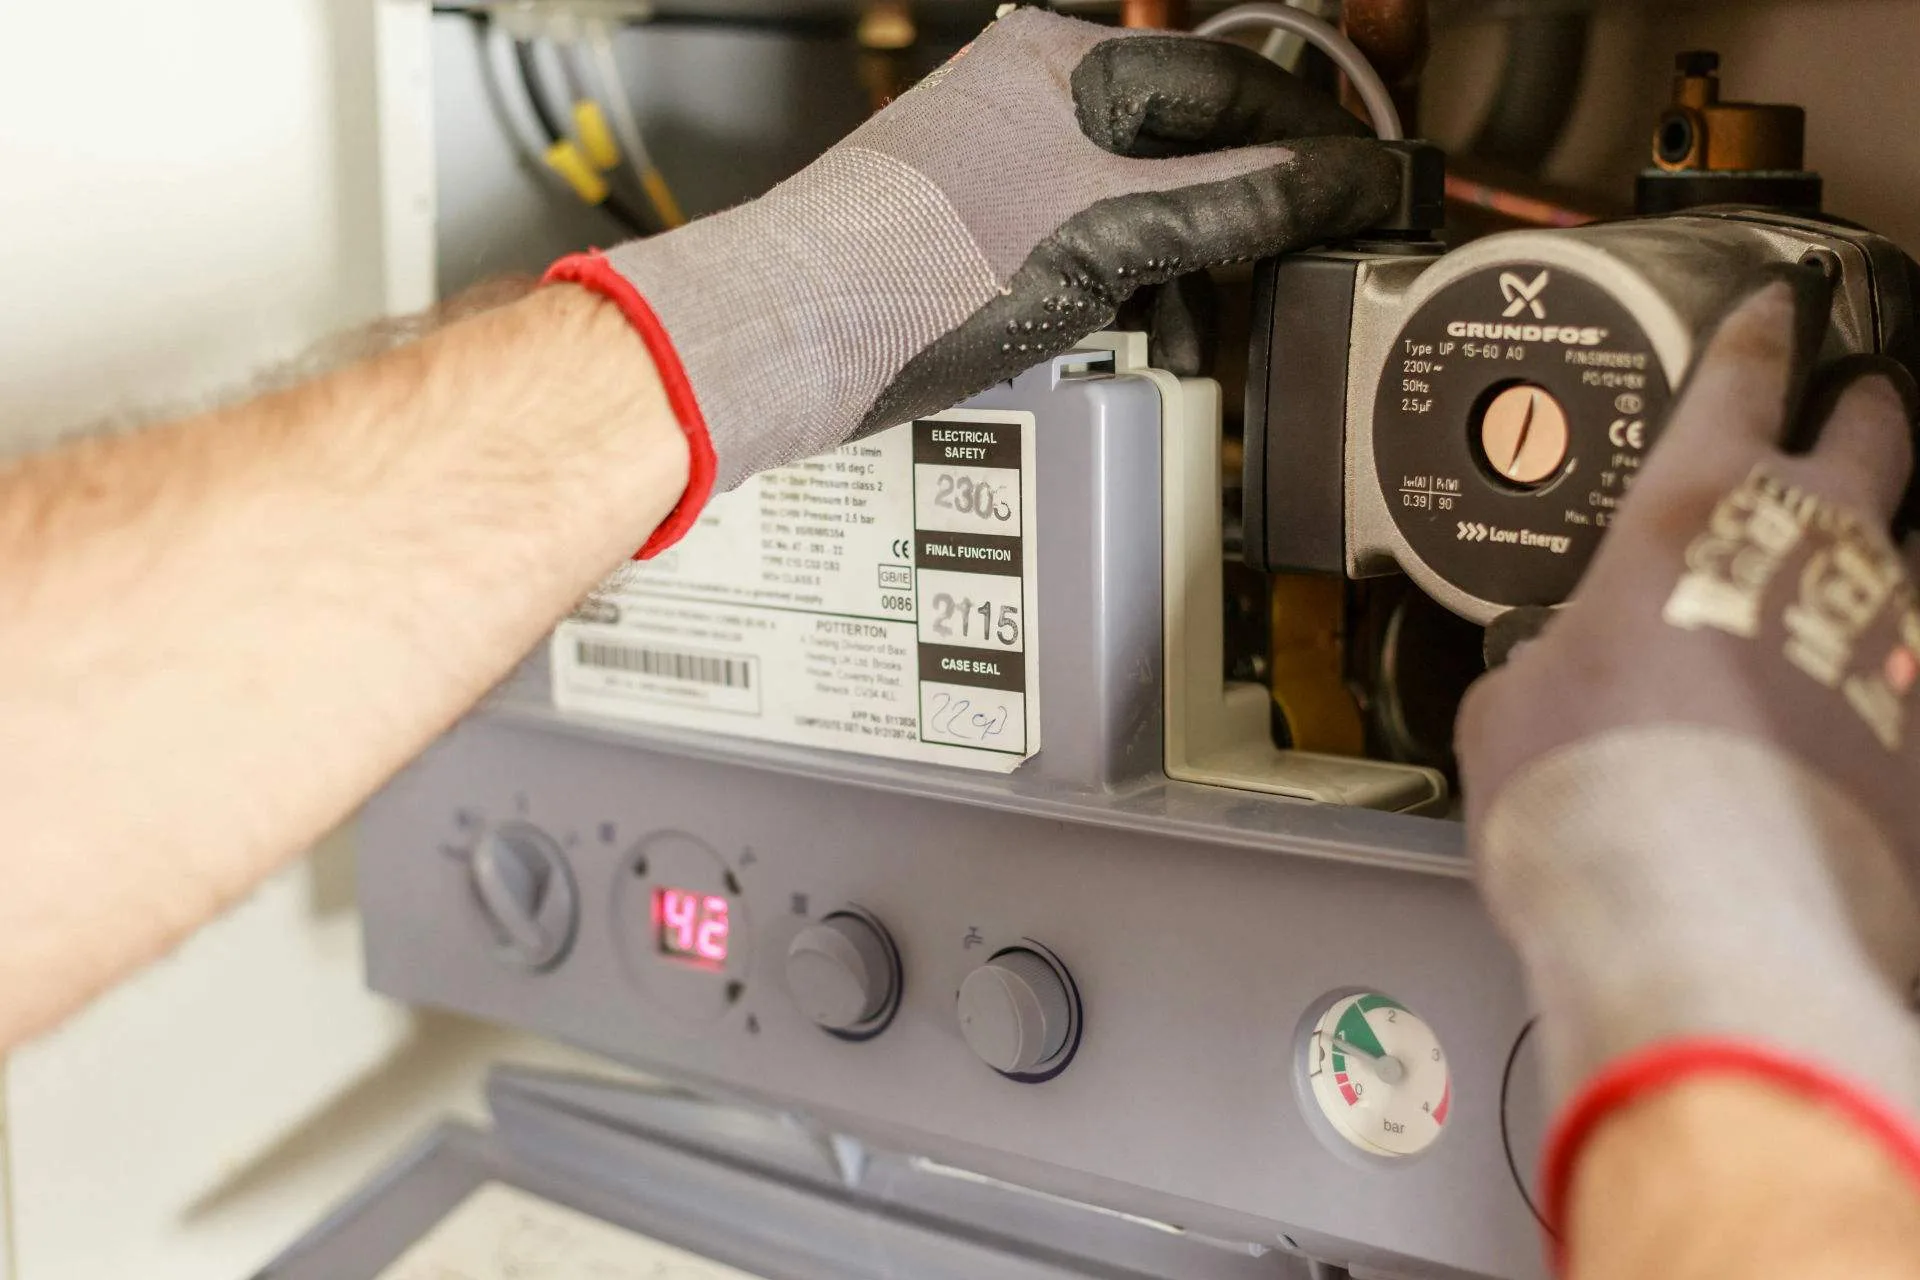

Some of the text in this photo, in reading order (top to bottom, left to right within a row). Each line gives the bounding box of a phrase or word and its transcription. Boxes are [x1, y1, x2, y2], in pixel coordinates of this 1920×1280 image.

[1446, 321, 1602, 346] GRUNDFOS
[1404, 340, 1432, 356] Type
[1439, 342, 1454, 356] UP
[1461, 343, 1499, 360] 15-60
[1402, 379, 1429, 393] 50Hz
[931, 429, 998, 444] ELECTRICAL
[945, 446, 986, 460] SAFETY
[1403, 494, 1452, 510] 0.39 90
[1489, 525, 1572, 554] Low Energy
[925, 543, 1012, 562] FINAL FUNCTION
[881, 595, 912, 612] 0086
[932, 592, 1019, 646] 2115
[815, 620, 887, 639] POTTERTON
[941, 657, 1001, 676] CASE SEAL
[664, 889, 728, 960] 42
[1387, 1009, 1396, 1023] 2
[1432, 1048, 1440, 1062] 3
[1355, 1083, 1363, 1096] 0
[1422, 1100, 1431, 1114] 4
[1384, 1118, 1405, 1134] bar
